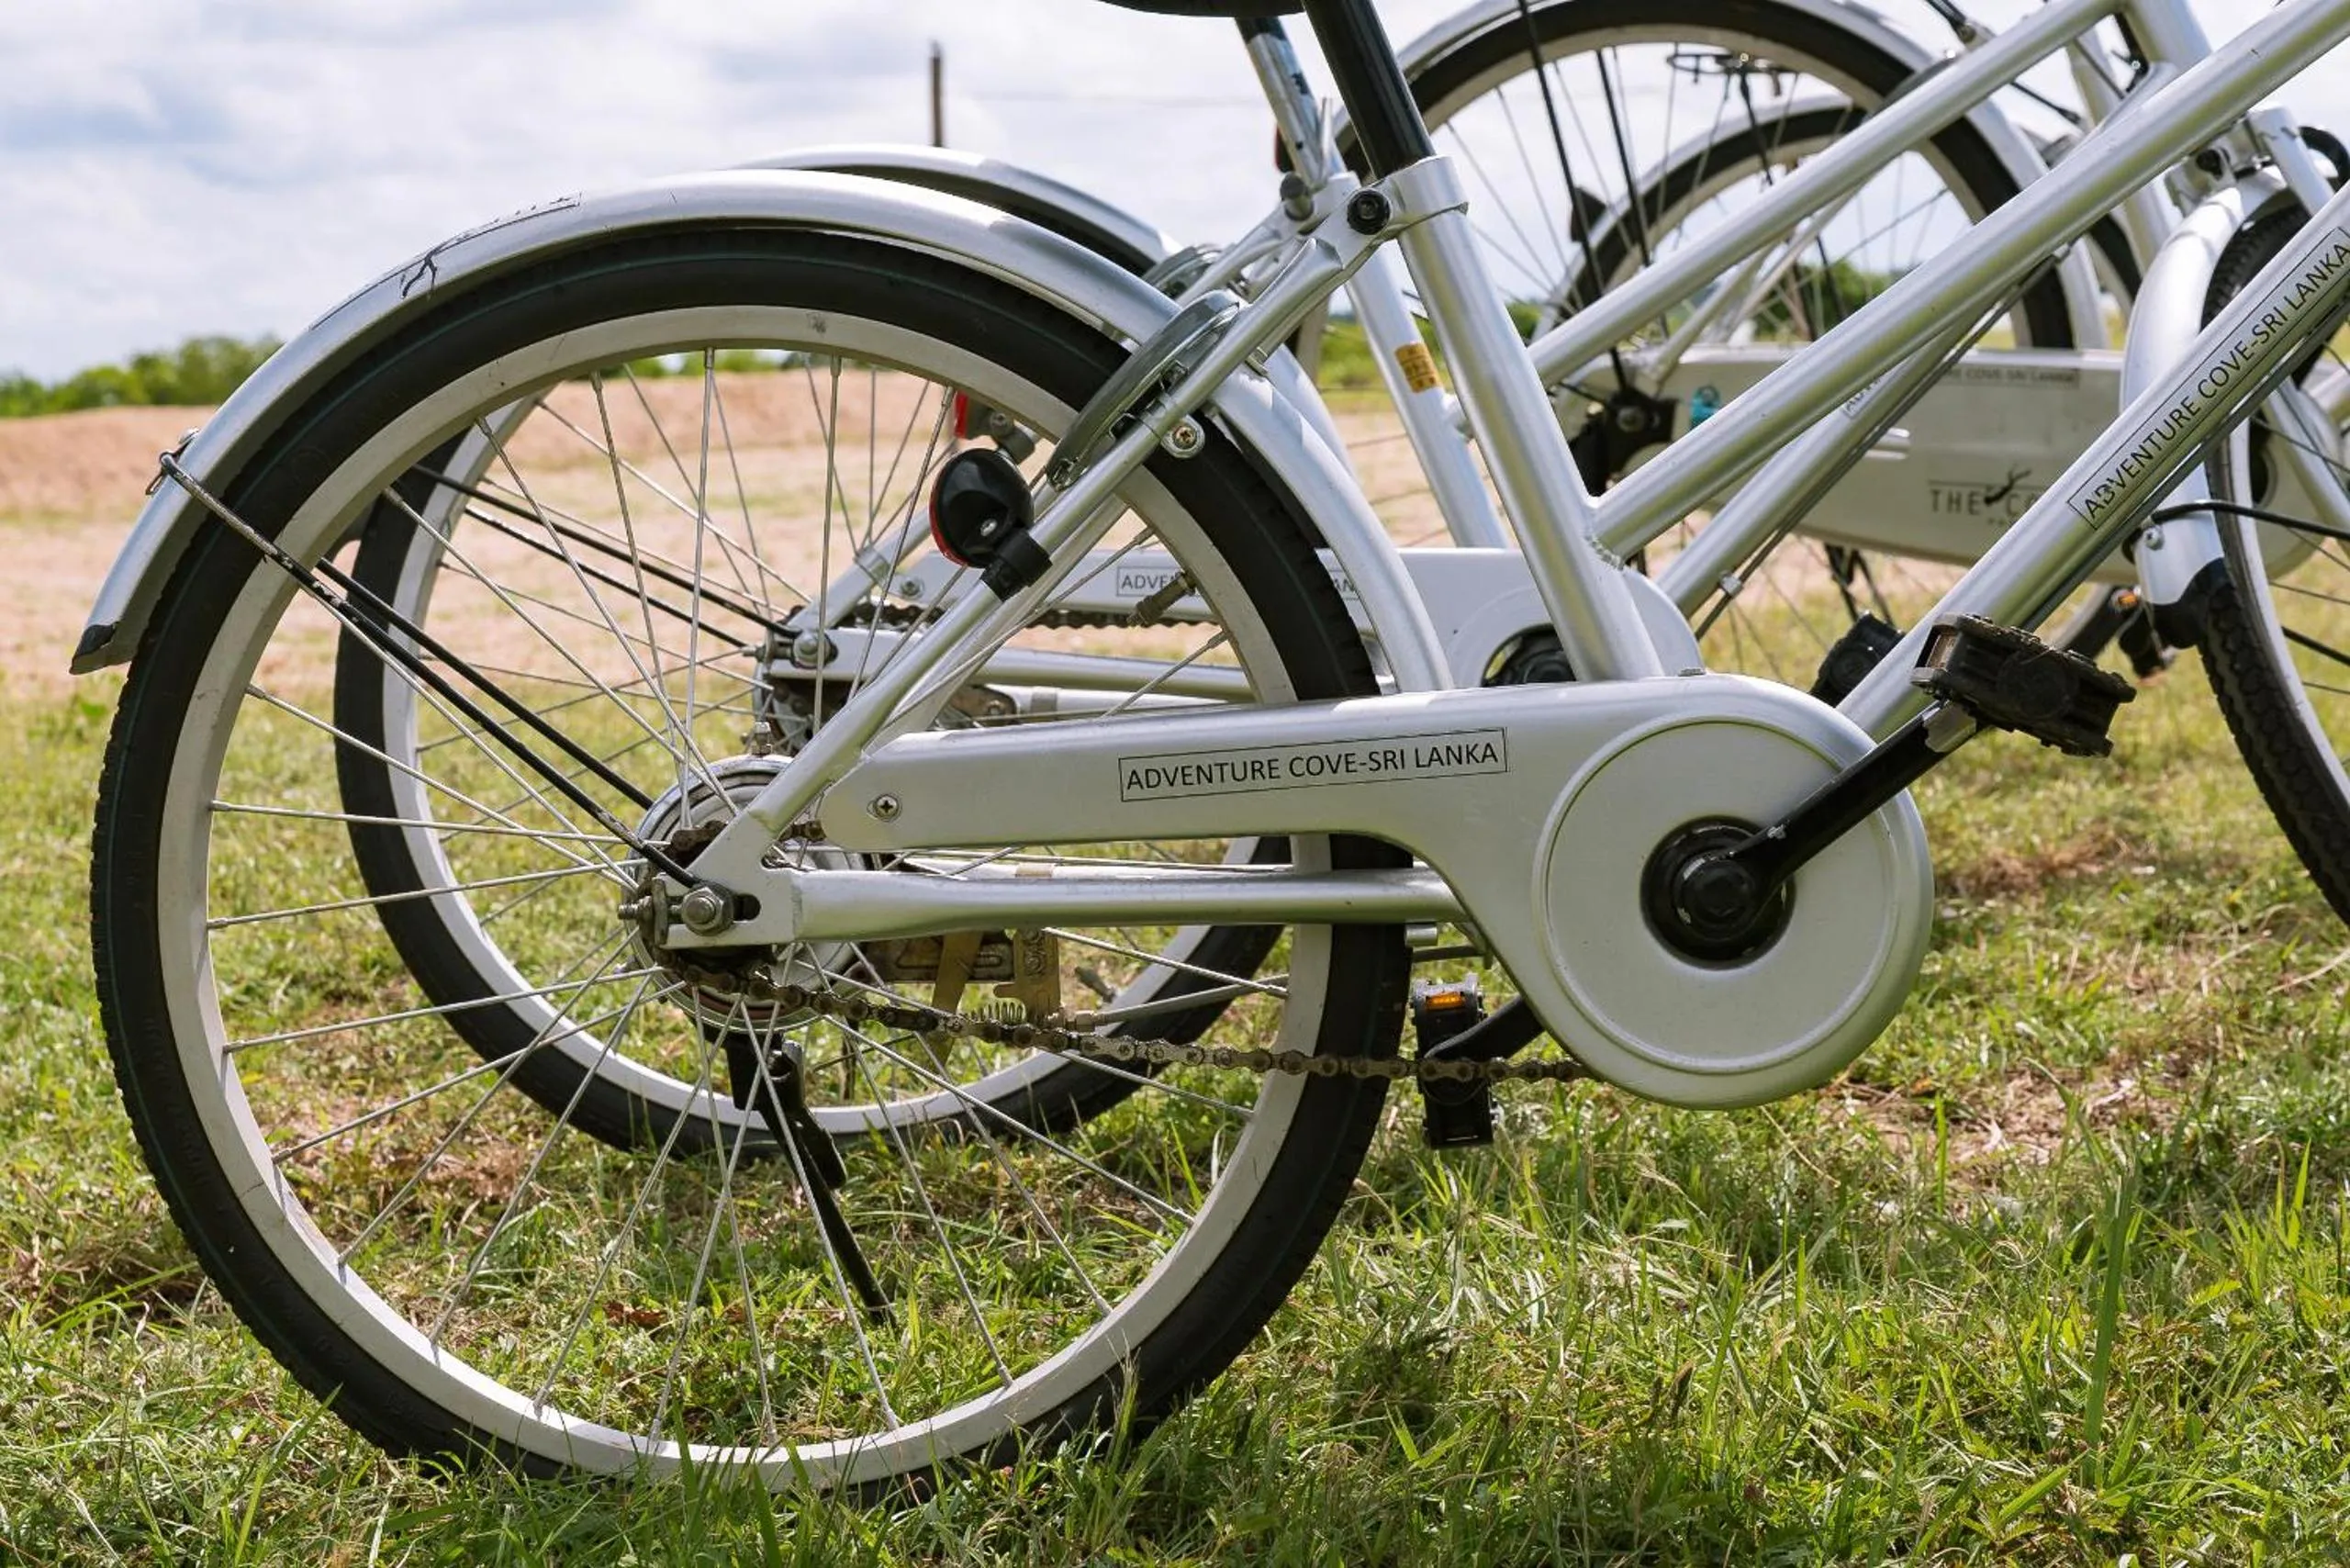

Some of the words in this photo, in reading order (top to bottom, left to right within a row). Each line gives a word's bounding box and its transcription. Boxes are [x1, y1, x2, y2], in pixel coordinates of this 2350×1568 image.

[2197, 306, 2288, 399] COVE-SRI
[2283, 243, 2350, 310] LANKA
[1930, 488, 1981, 516] THE
[1126, 758, 1281, 790] ADVENTURE
[1288, 748, 1405, 778] COVE-SRI
[1415, 742, 1499, 769] LANKA
